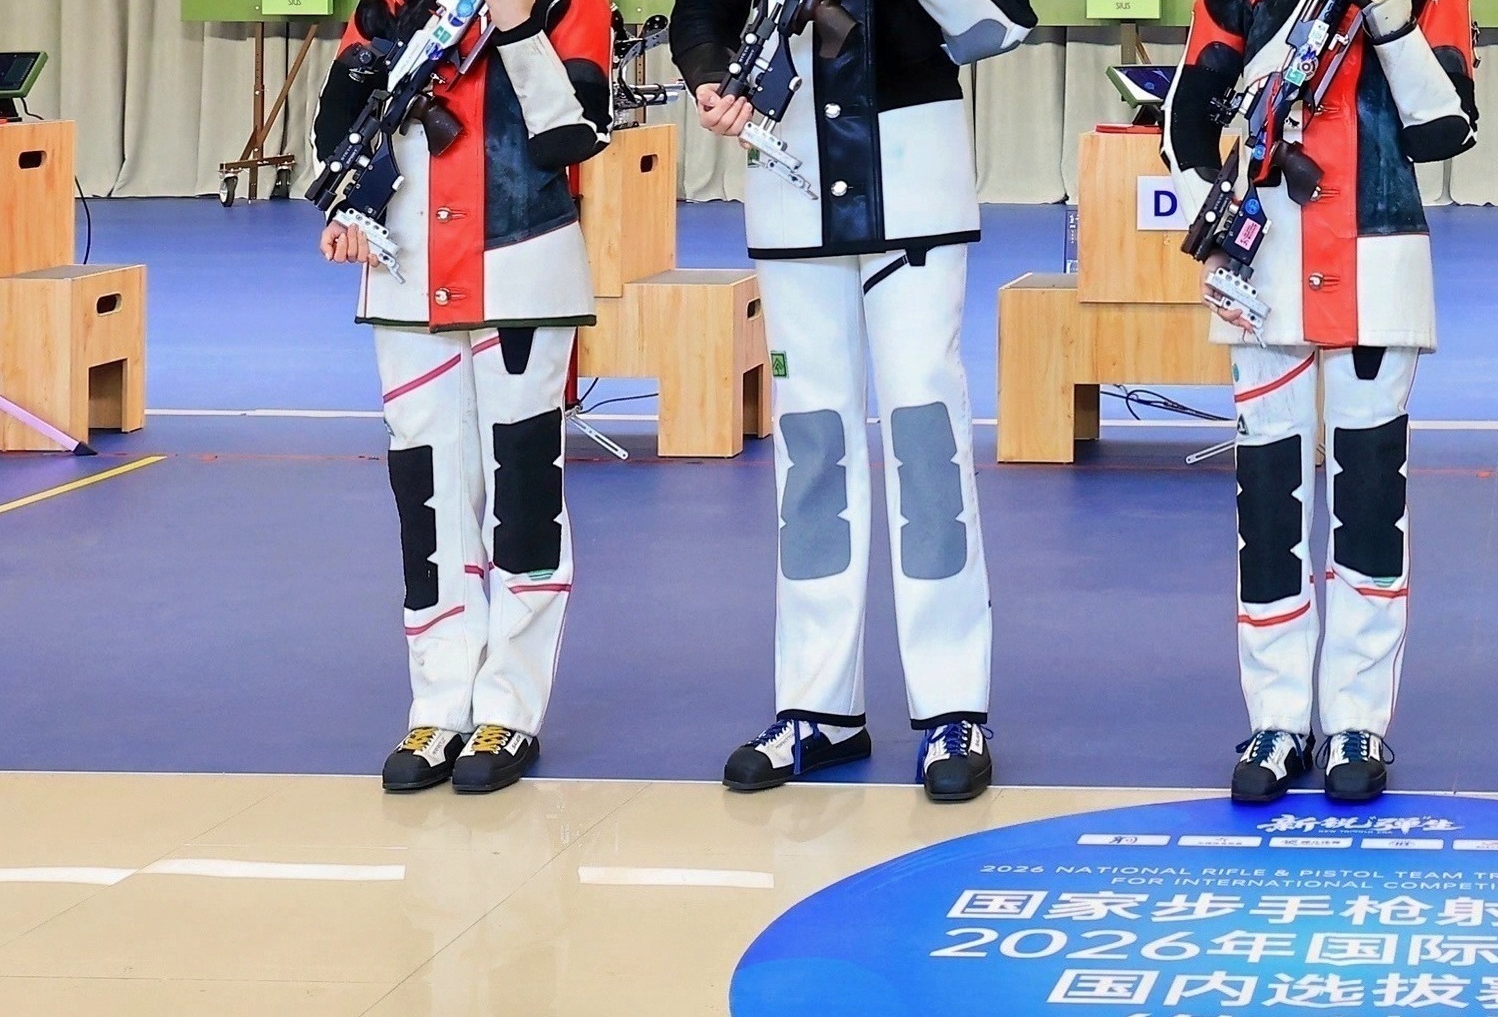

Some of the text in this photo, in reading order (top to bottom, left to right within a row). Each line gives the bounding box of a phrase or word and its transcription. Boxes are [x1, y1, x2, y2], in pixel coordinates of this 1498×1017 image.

[1116, 2, 1131, 10] SIUS
[1154, 190, 1178, 217] D
[980, 865, 1045, 873] 2026
[1055, 866, 1192, 876] NATIONAL
[1202, 868, 1266, 877] RIFLE
[1274, 869, 1289, 878] &
[1299, 870, 1383, 879] PISTOL
[1396, 871, 1462, 880] TEAM
[1110, 877, 1164, 885] FOR
[1174, 878, 1373, 889] INTERNATIONAL
